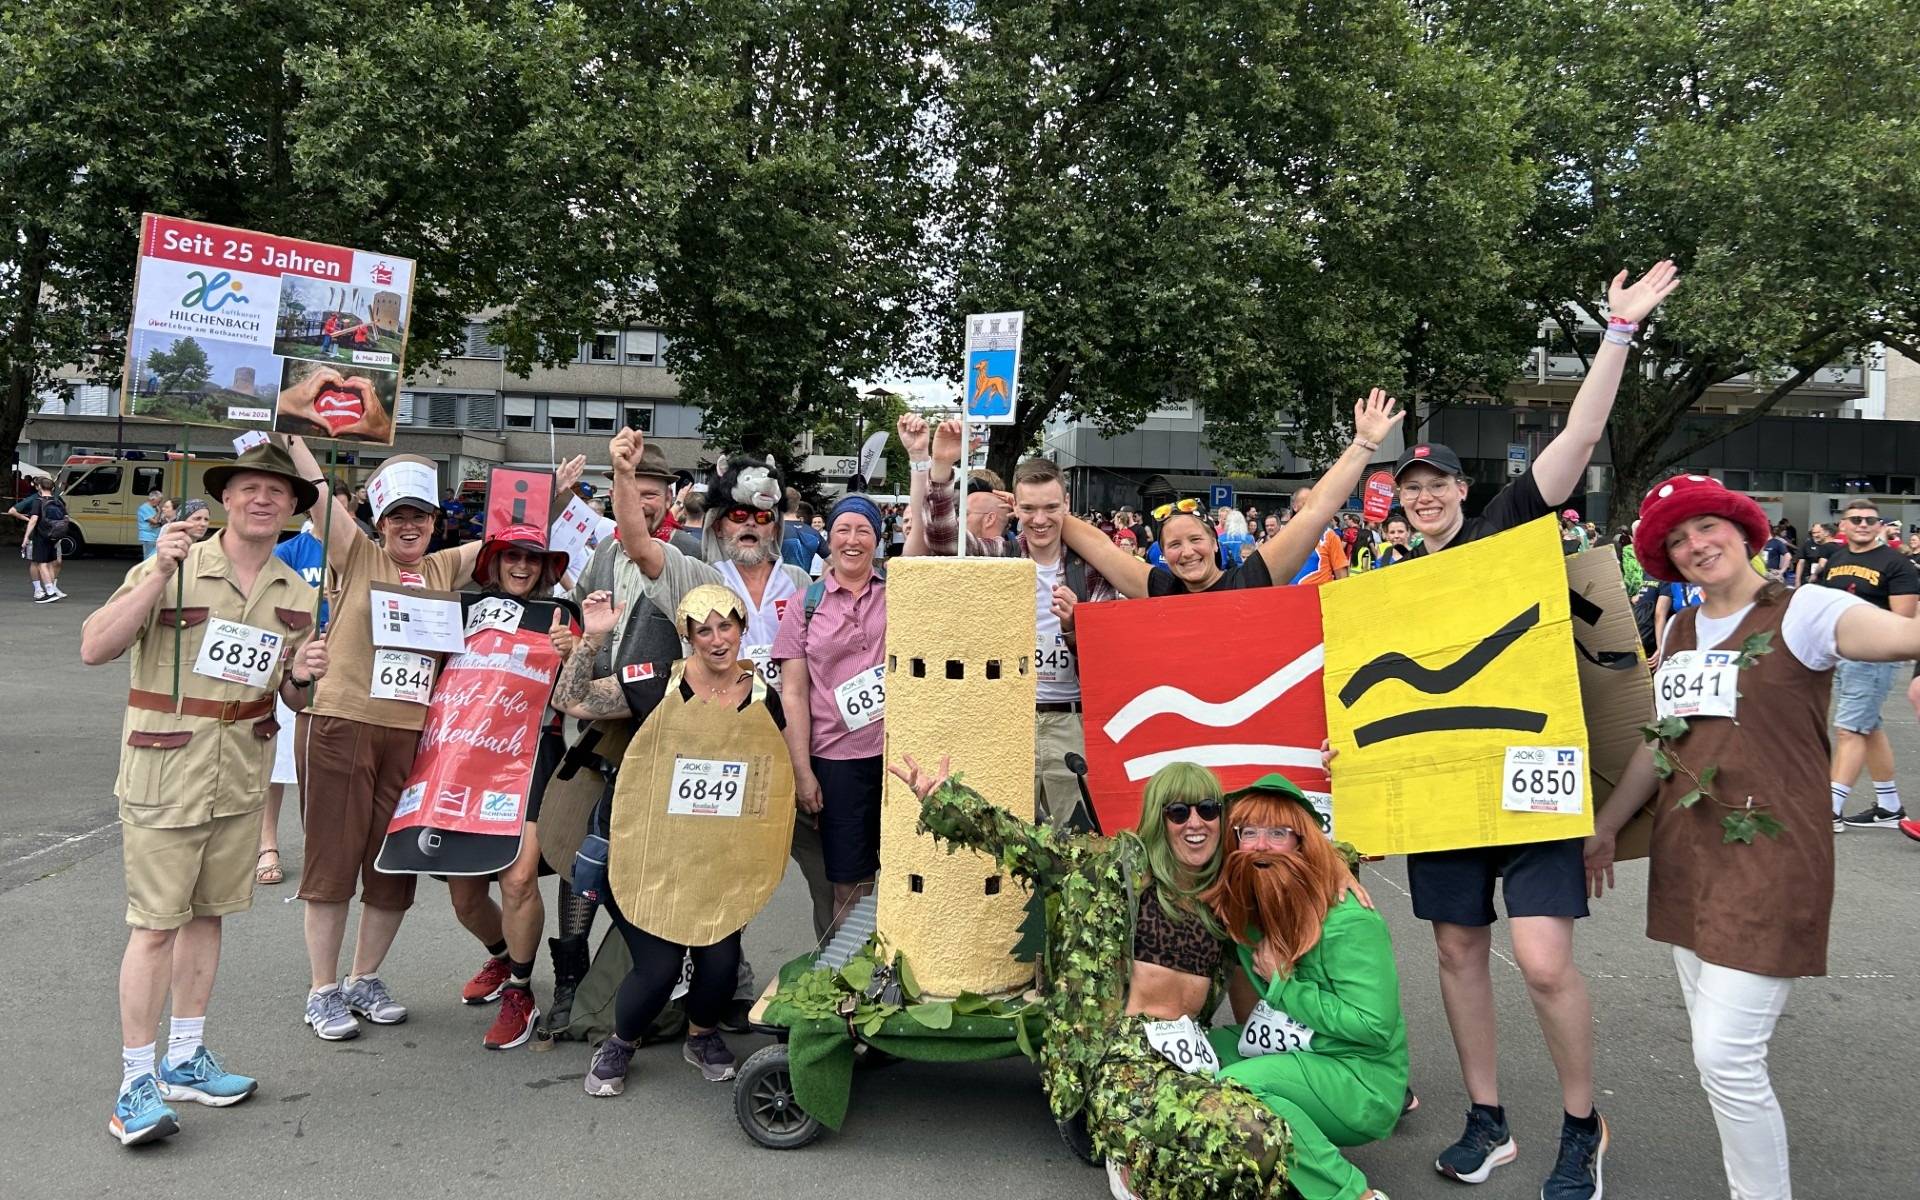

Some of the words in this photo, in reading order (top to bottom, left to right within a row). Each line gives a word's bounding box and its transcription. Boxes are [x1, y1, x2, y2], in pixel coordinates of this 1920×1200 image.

[163, 229, 214, 257] Seit
[223, 240, 253, 263] 25
[261, 246, 341, 277] Jahren
[170, 310, 260, 331] HILCHENBACH
[209, 328, 258, 342] Rothaarsteig
[1215, 487, 1228, 505] P
[217, 624, 239, 635] AOK
[469, 607, 516, 629] 6847
[208, 640, 271, 672] 6838
[383, 653, 402, 661] AOK
[1034, 648, 1070, 669] 845
[380, 666, 430, 691] 6844
[1661, 671, 1721, 701] 6841
[432, 681, 528, 717] urist-Info
[847, 684, 886, 716] 683
[1513, 750, 1535, 760] AOK
[682, 763, 702, 771] AOK
[678, 778, 738, 802] 6849
[1511, 768, 1576, 796] 6850
[1155, 1022, 1176, 1031] AOK
[1245, 1020, 1305, 1052] 6833
[1161, 1038, 1213, 1065] 6848
